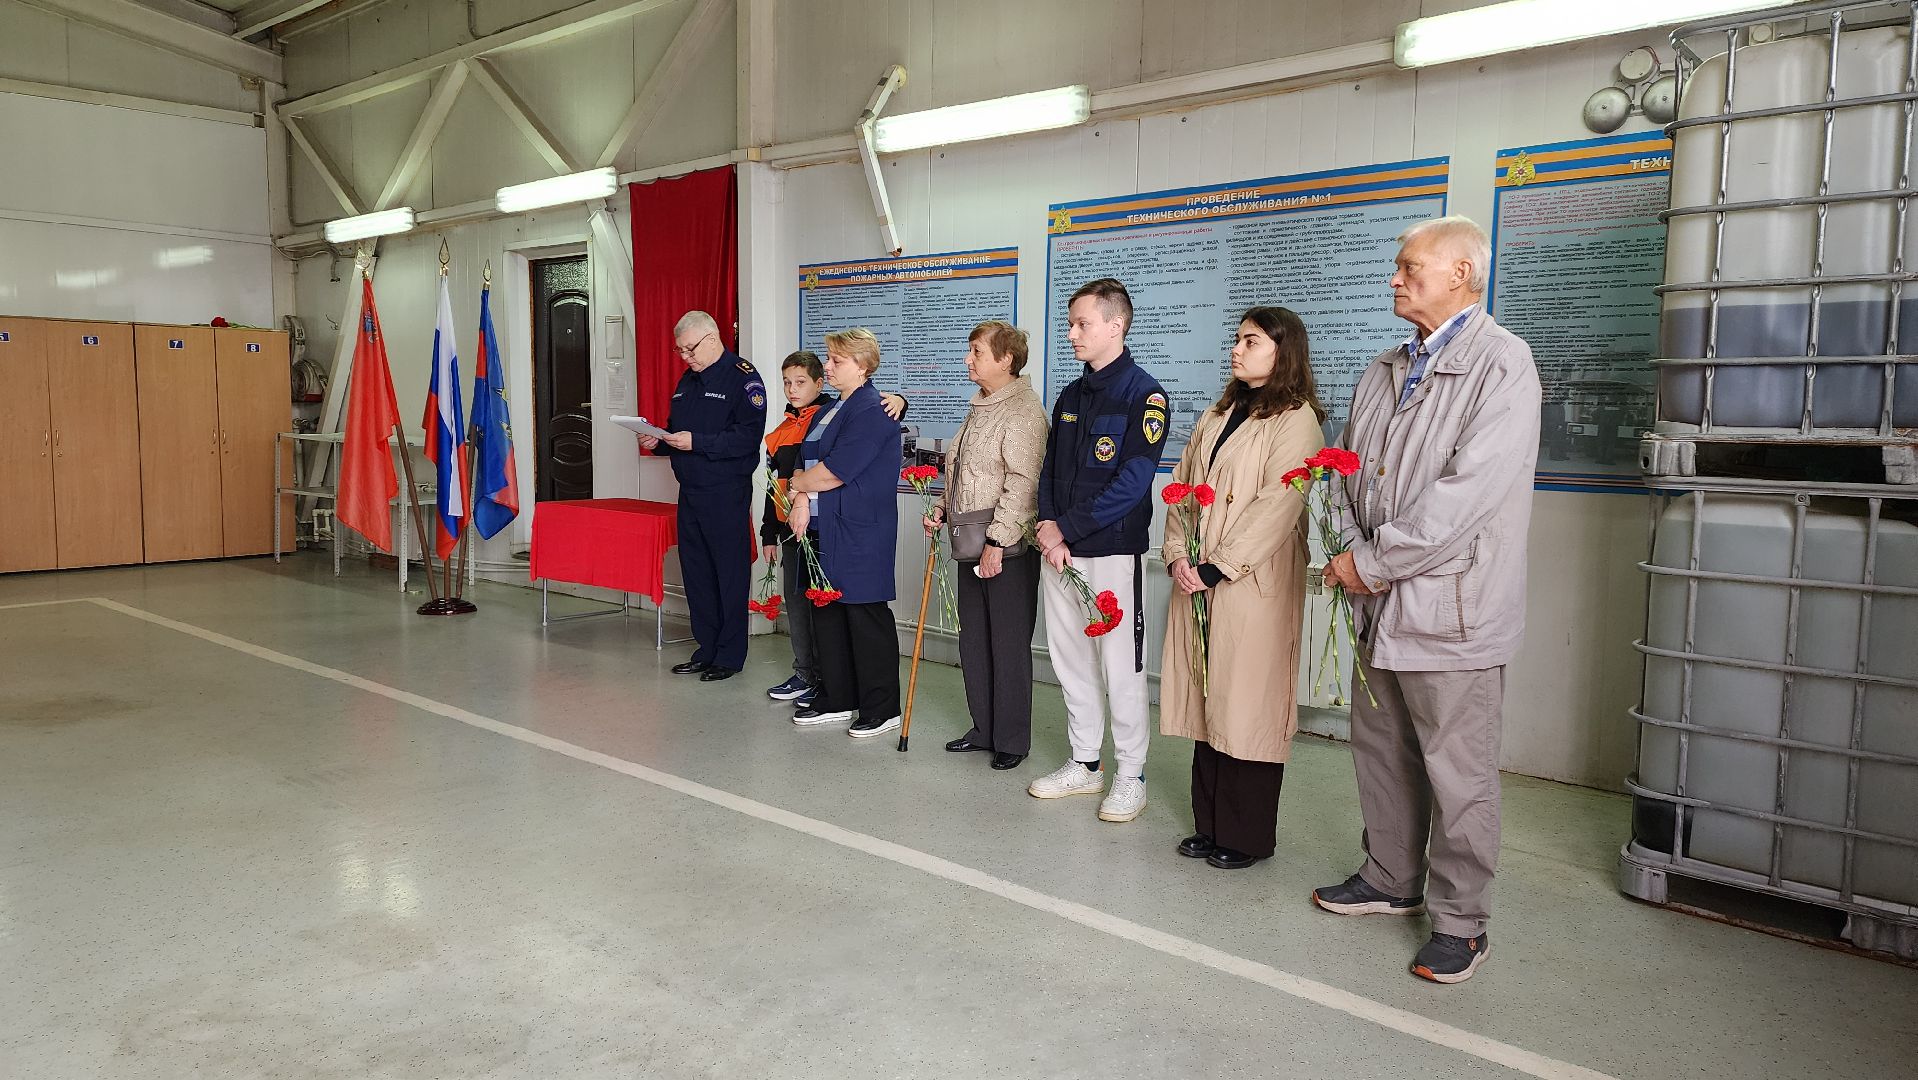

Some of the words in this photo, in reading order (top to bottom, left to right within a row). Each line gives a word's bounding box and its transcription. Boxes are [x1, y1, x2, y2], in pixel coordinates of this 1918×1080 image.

[1630, 156, 1671, 170] ТЕХН
[1186, 189, 1260, 206] ПРОВЕДЕНИЕ
[1127, 206, 1208, 224] ТЕХНИЧЕСКОГО
[1212, 196, 1308, 213] ОБСЛУЖИВАНИЯ
[1311, 193, 1331, 203] №1
[819, 265, 867, 276] ЕЖЕДНЕВНОЕ
[868, 260, 923, 272] ТЕХНИЧЕСКОЕ
[923, 255, 991, 268] ОБСЛУЖИВАНИЕ
[850, 273, 893, 282] ПОЖАРНЫХ
[894, 267, 953, 280] АВТОМОБИЛЕЙ
[88, 337, 94, 345] 6
